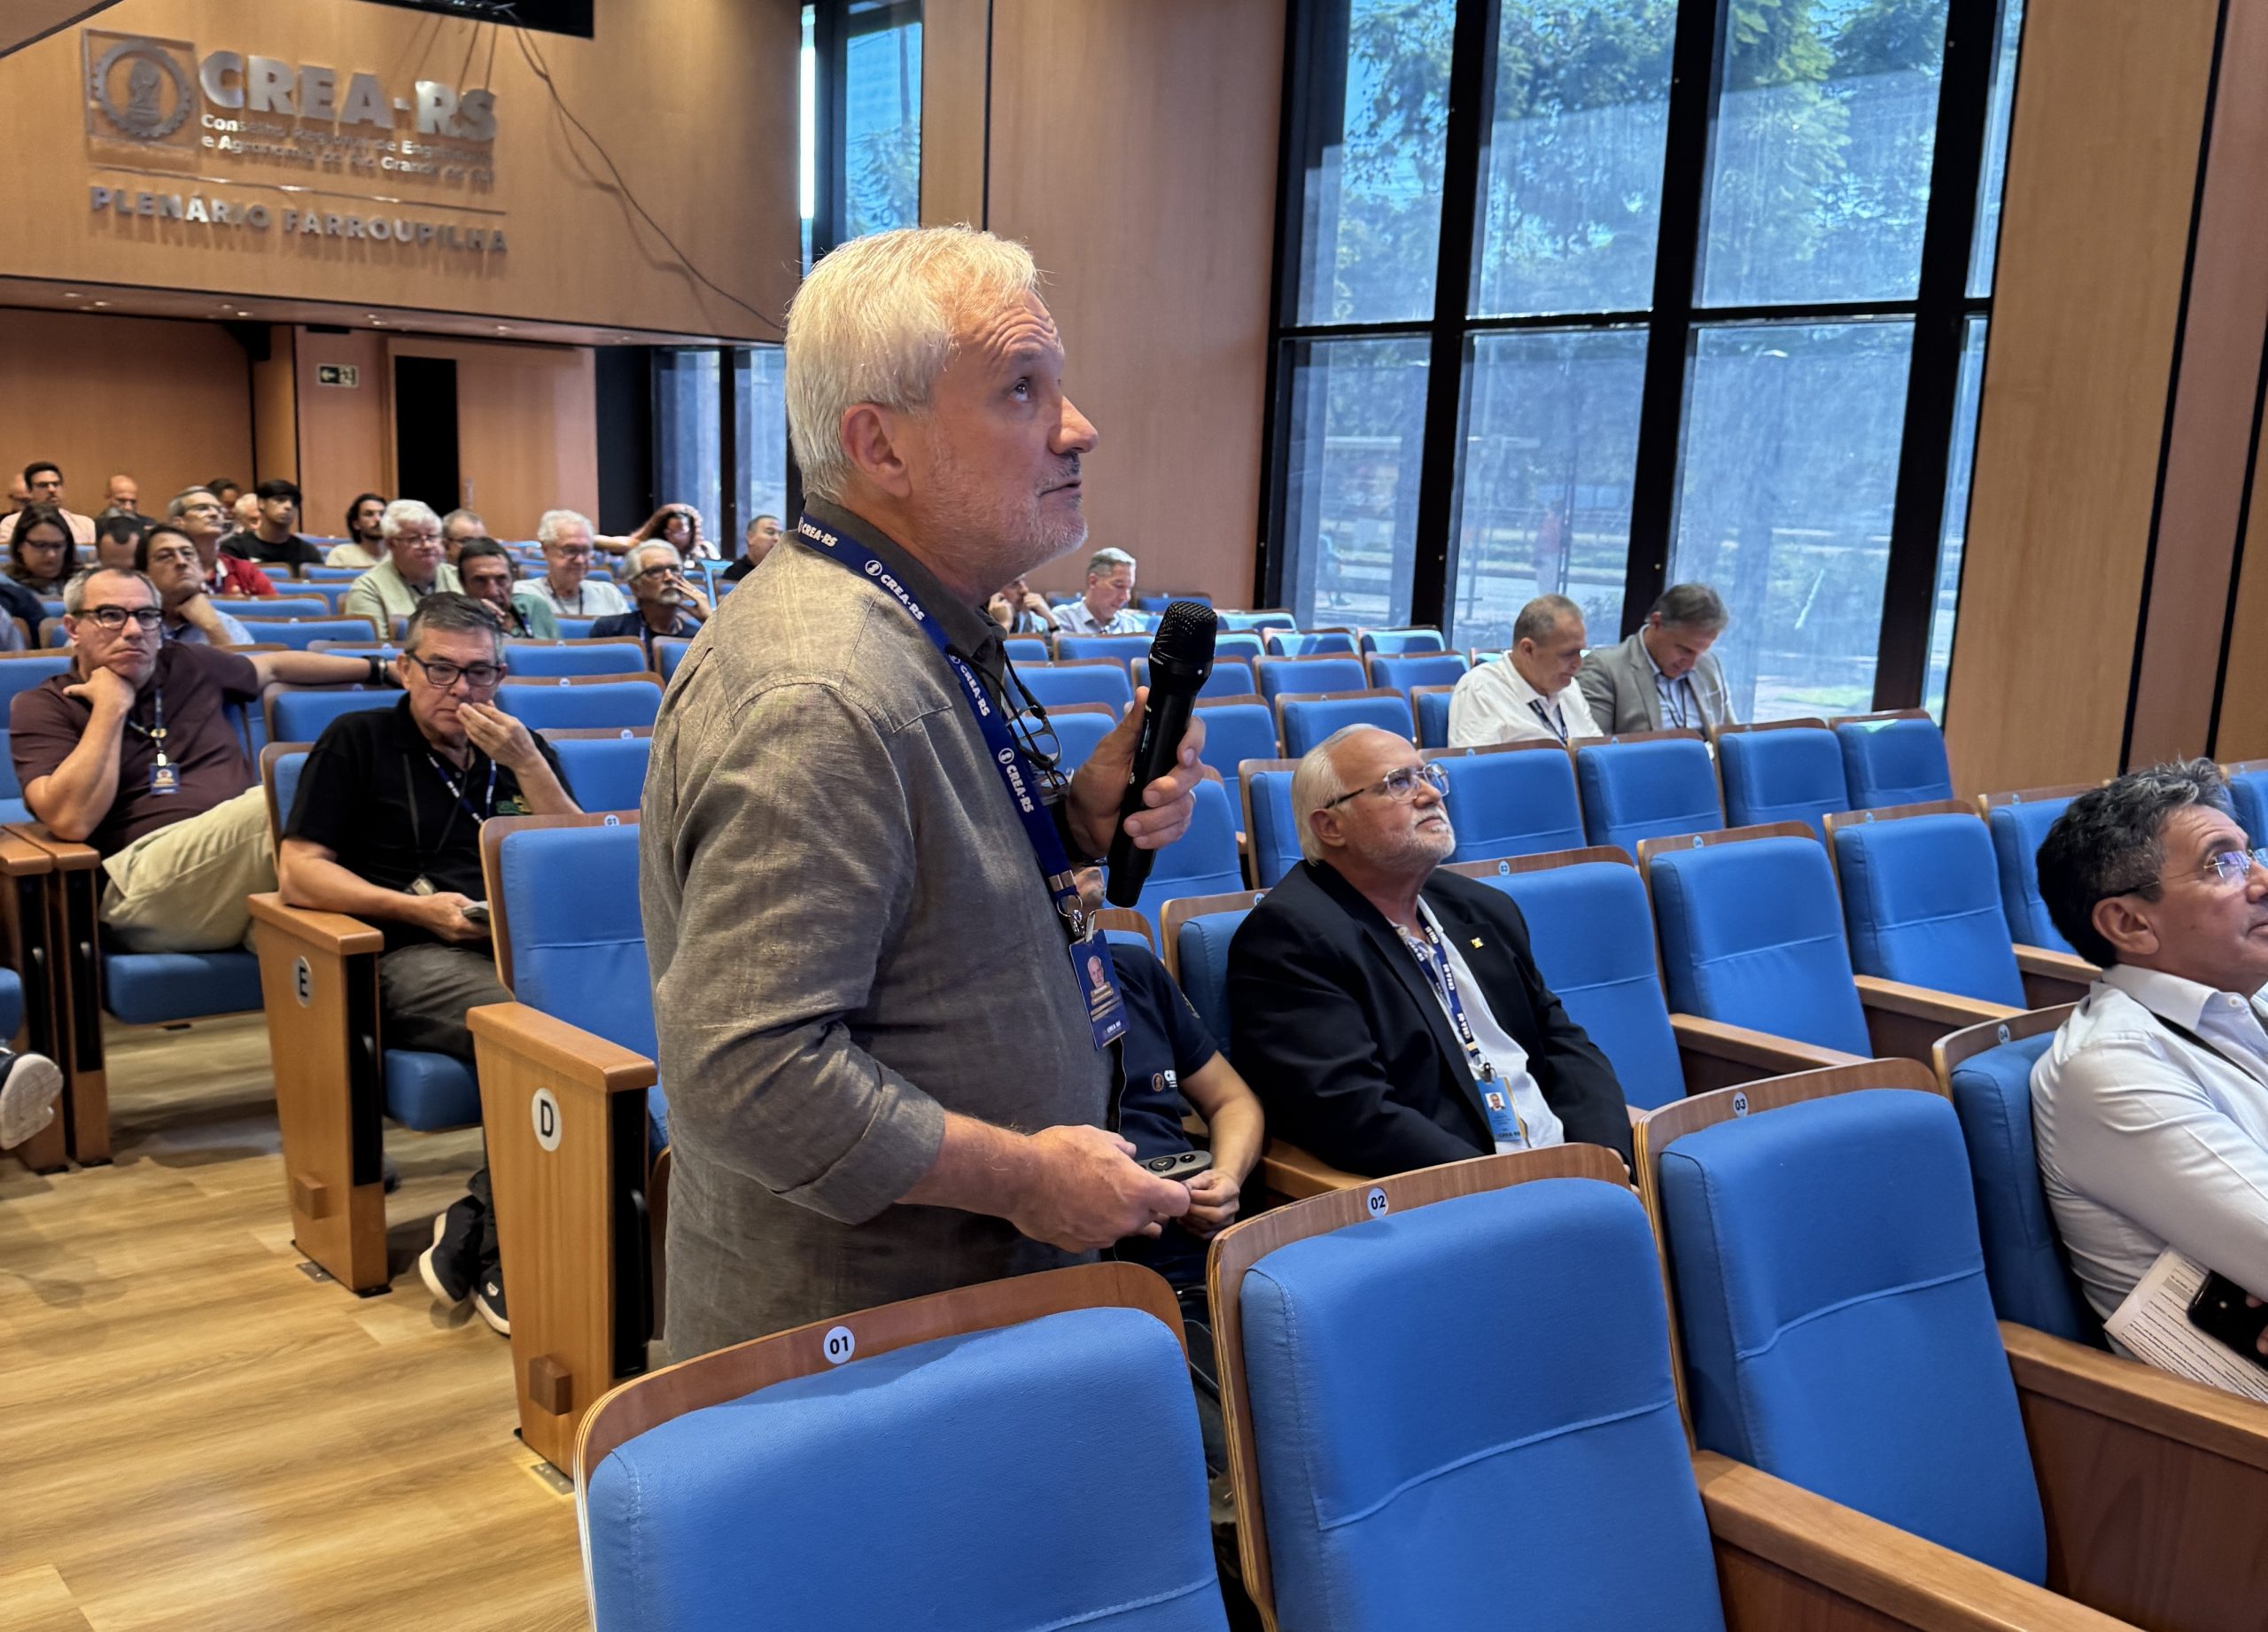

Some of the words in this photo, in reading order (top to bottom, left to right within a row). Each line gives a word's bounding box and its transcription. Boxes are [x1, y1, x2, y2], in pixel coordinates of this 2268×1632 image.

[199, 50, 498, 142] CREA-RS
[90, 185, 271, 229] PLENÁRIO
[282, 208, 509, 253] FARROUPILHA
[802, 523, 839, 548] CREA-RS
[880, 574, 926, 621] CREA-RS
[959, 665, 991, 717] CREA-RS
[1006, 764, 1035, 813] CREA-RS
[299, 966, 309, 999] E
[540, 1099, 555, 1139] D
[1735, 1098, 1746, 1111] 03
[1371, 1194, 1386, 1210] 02
[829, 1335, 849, 1355] 01
